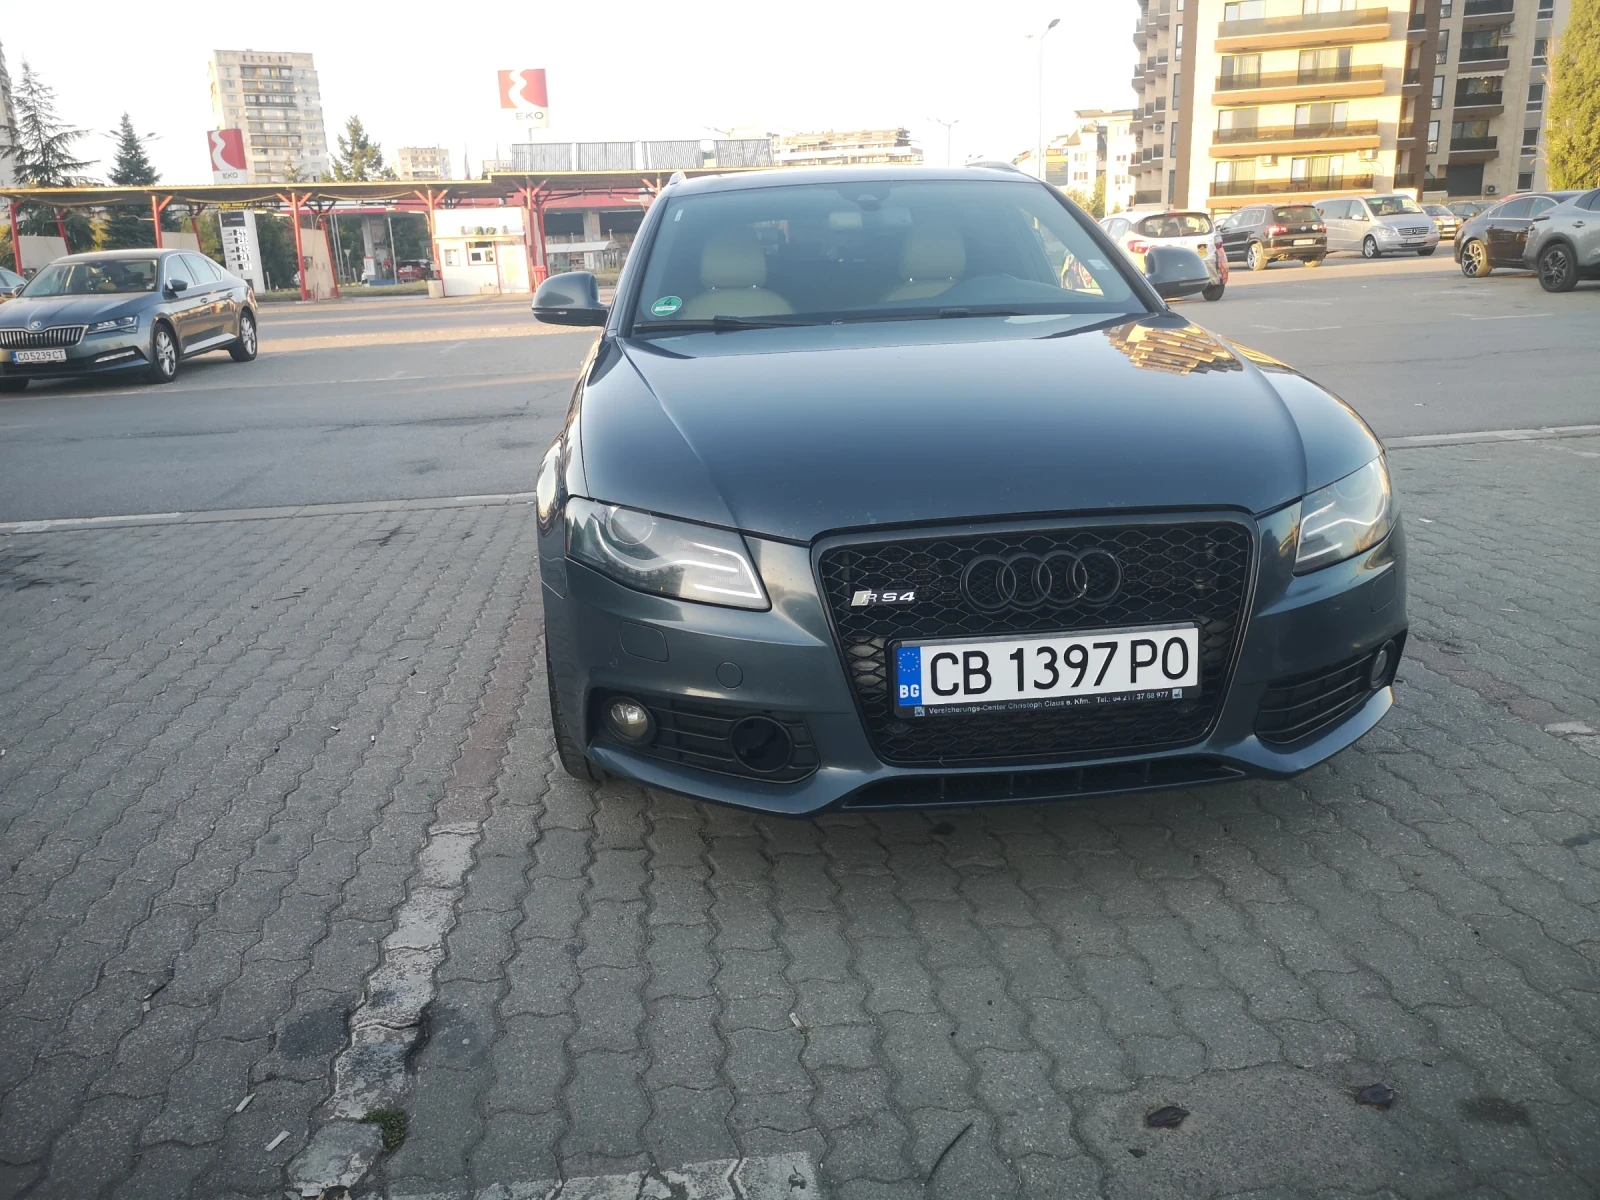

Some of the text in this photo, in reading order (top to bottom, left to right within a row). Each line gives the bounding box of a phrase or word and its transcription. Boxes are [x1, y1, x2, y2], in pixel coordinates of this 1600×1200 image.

[515, 111, 544, 120] EKO
[222, 171, 239, 180] EKO
[53, 351, 64, 360] CT
[930, 636, 1189, 697] CB 1397 PO
[899, 684, 920, 699] BG
[928, 703, 1006, 715] Versicherungs-Center
[1008, 701, 1043, 710] Christoph
[1074, 697, 1091, 705] Kfm.
[1136, 692, 1145, 700] 37
[1156, 690, 1169, 699] 977
